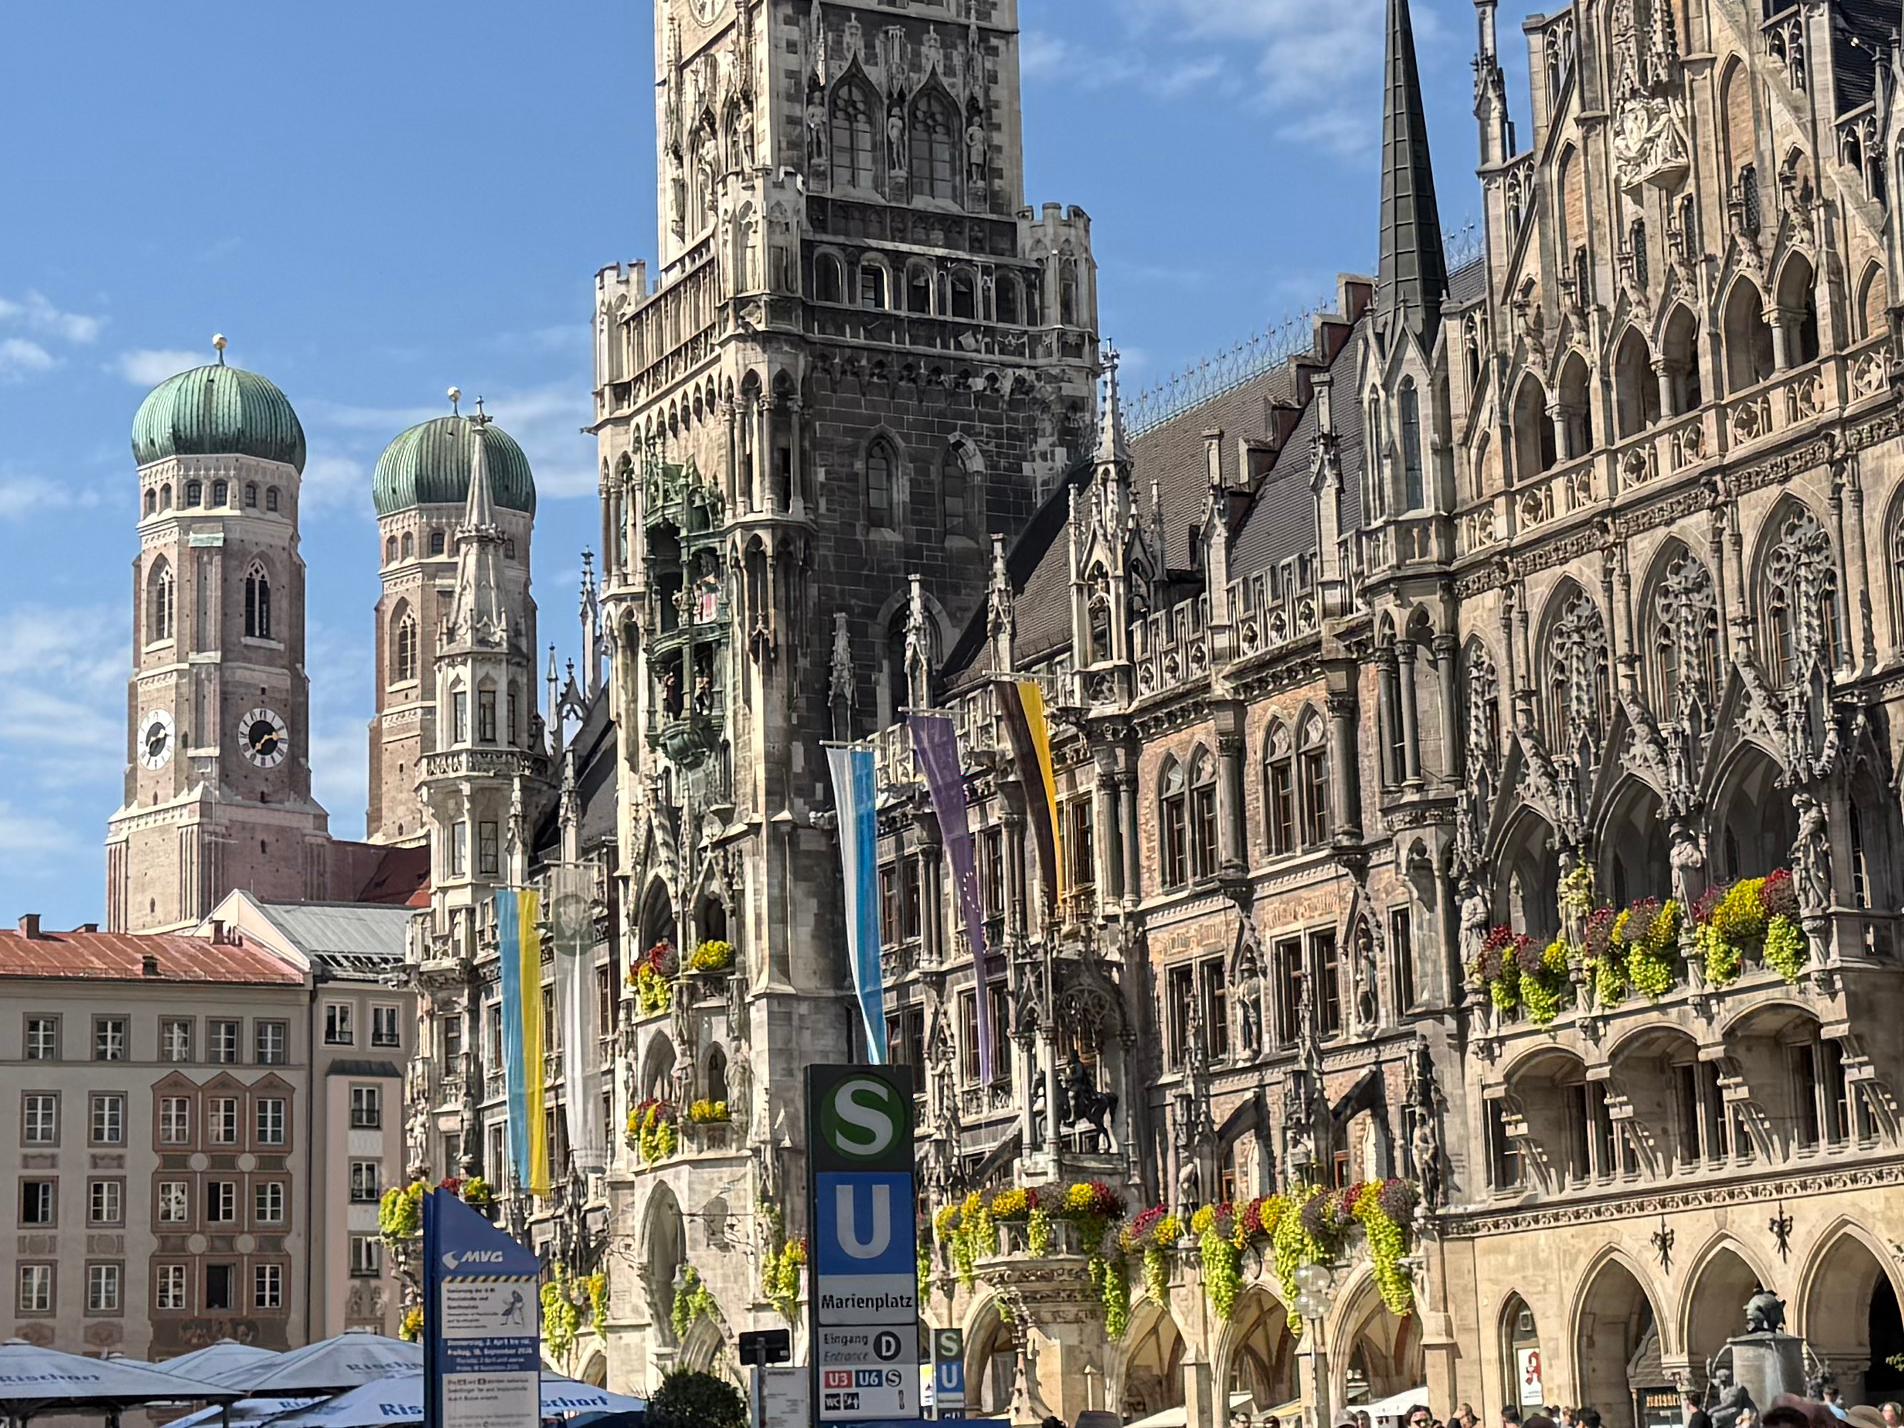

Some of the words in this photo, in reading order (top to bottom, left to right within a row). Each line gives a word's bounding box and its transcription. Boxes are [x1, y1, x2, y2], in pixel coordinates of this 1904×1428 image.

[834, 1079, 894, 1155] S
[836, 1184, 891, 1259] U
[461, 1250, 503, 1263] MVG
[821, 1293, 913, 1312] Marienplatz
[824, 1333, 868, 1346] Eingang
[881, 1336, 896, 1357] D
[940, 1332, 958, 1357] S
[824, 1351, 869, 1362] Entrance
[829, 1372, 848, 1386] U3
[859, 1372, 879, 1386] U6
[941, 1365, 958, 1389] U
